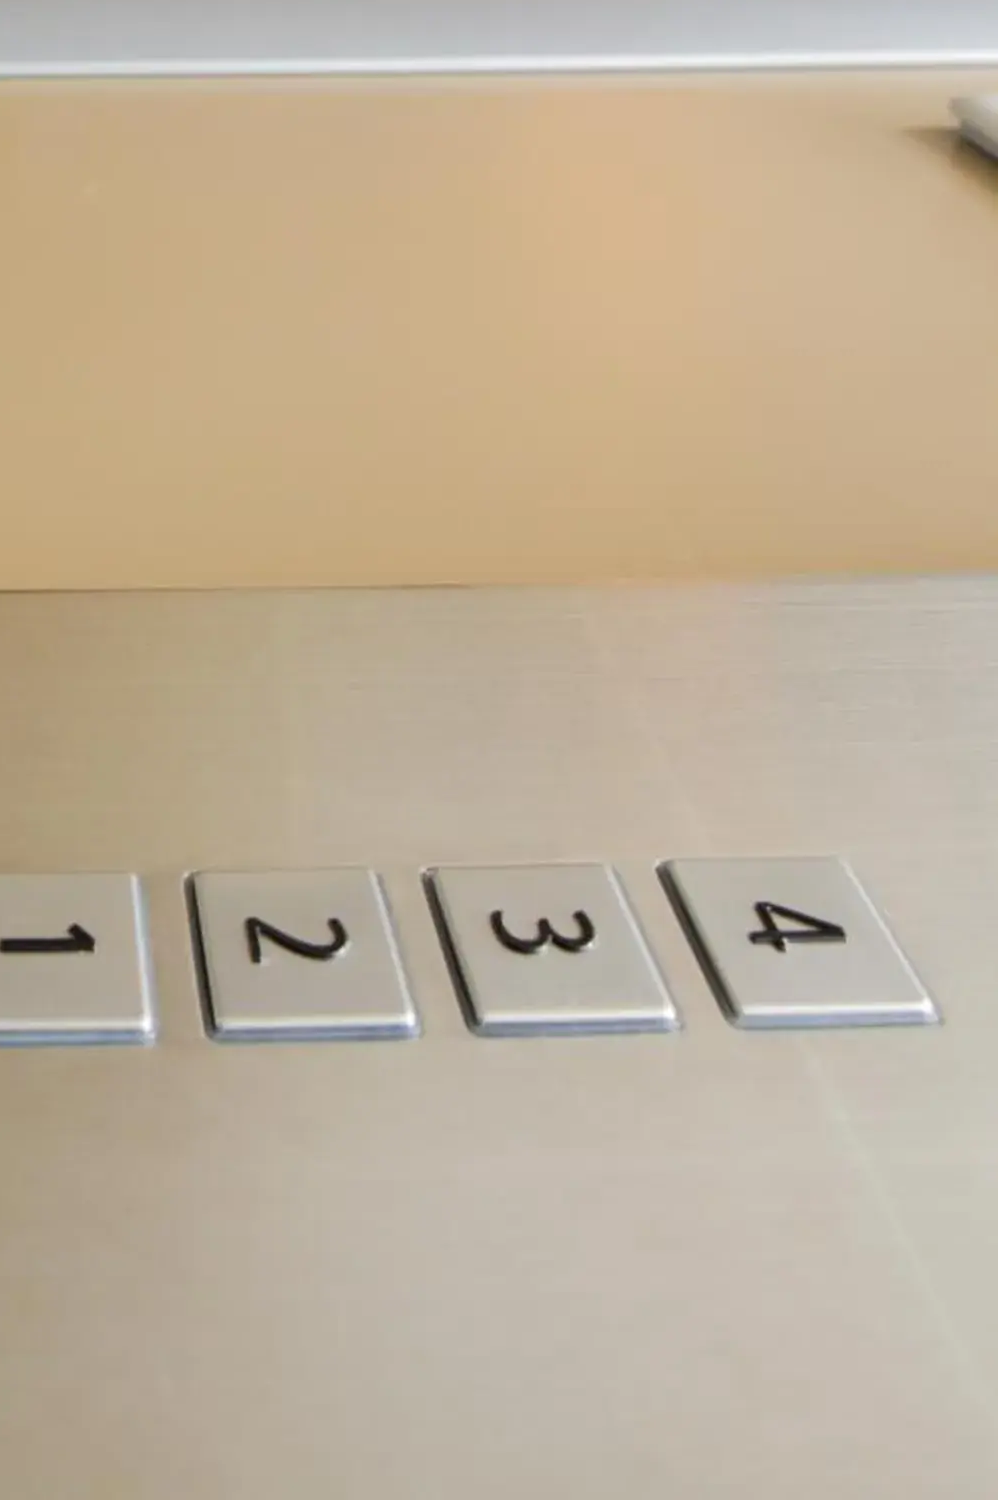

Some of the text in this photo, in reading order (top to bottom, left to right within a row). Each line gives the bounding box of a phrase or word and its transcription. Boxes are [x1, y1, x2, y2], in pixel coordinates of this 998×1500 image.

[245, 916, 347, 963] 2
[490, 910, 594, 956] 3
[748, 900, 844, 952] 4
